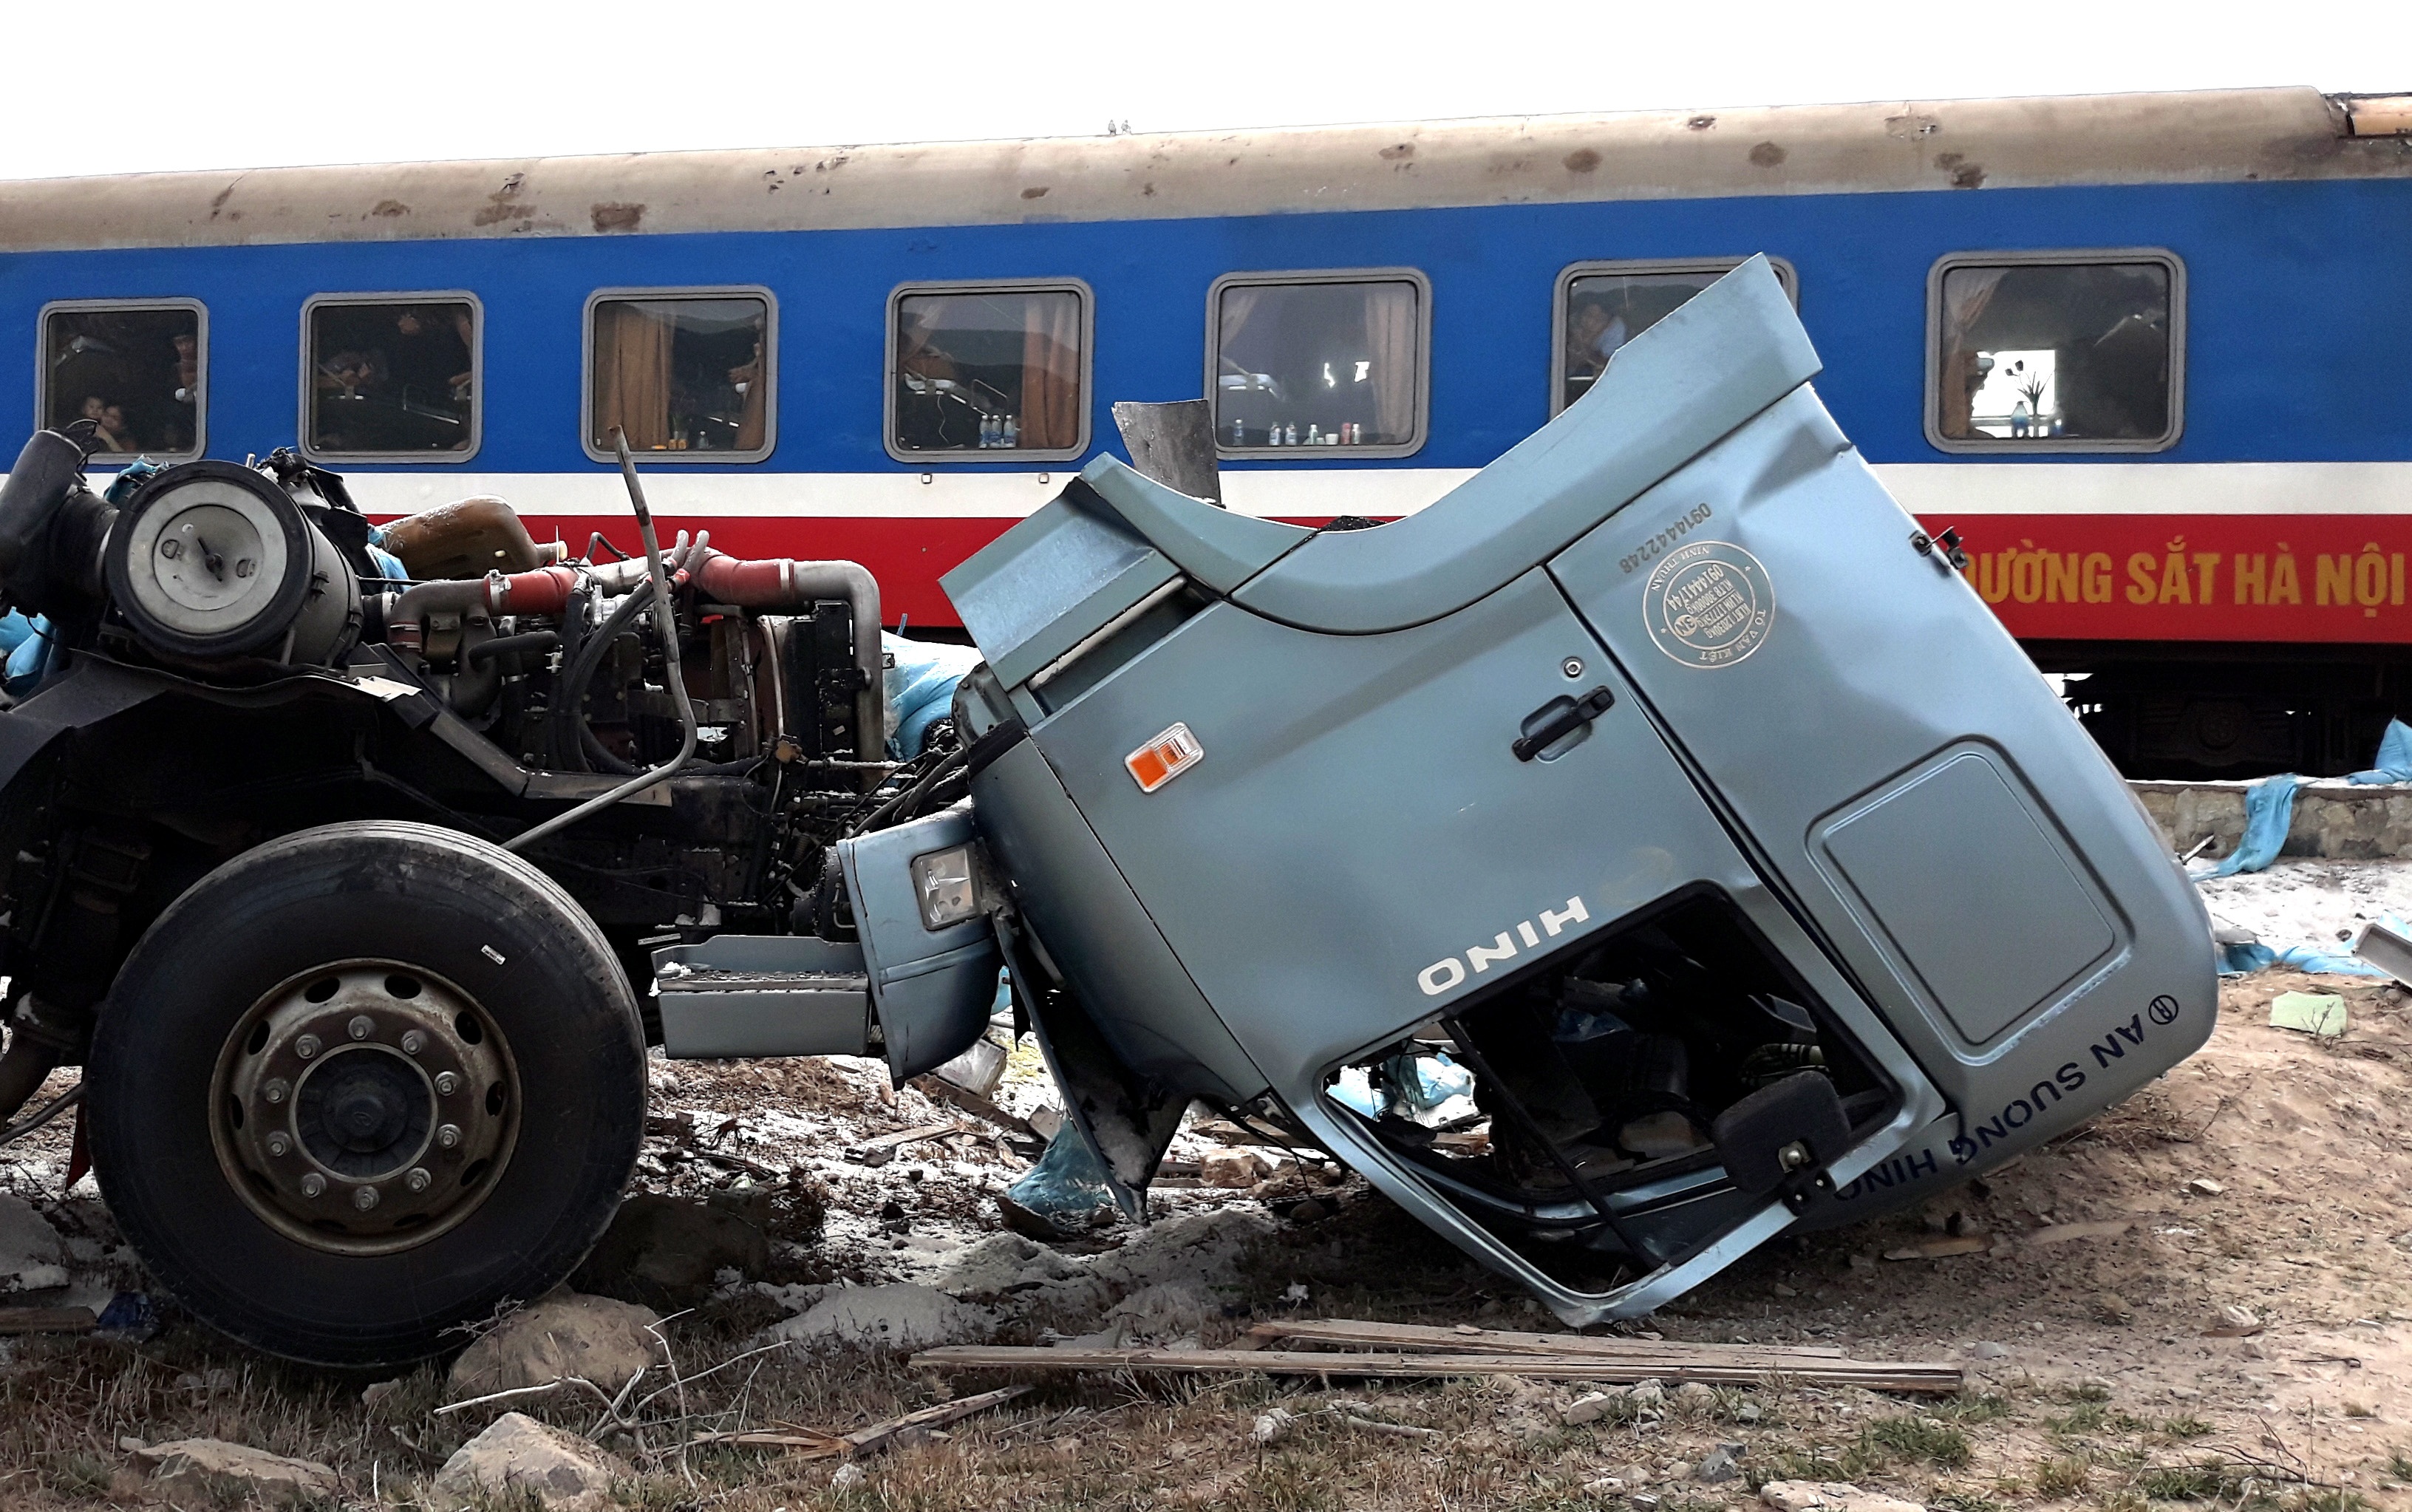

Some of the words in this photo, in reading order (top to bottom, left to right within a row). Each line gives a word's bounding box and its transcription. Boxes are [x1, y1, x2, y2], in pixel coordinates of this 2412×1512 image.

[1618, 503, 1712, 573] 0914442248
[1666, 564, 1724, 611] 0914441744
[2125, 535, 2221, 605] SẮT
[2235, 542, 2302, 605] HÀ
[2316, 542, 2405, 618] NỘI
[1417, 896, 1590, 995] HINO
[2090, 1013, 2144, 1069] AN
[1947, 1063, 2087, 1165] SUONG
